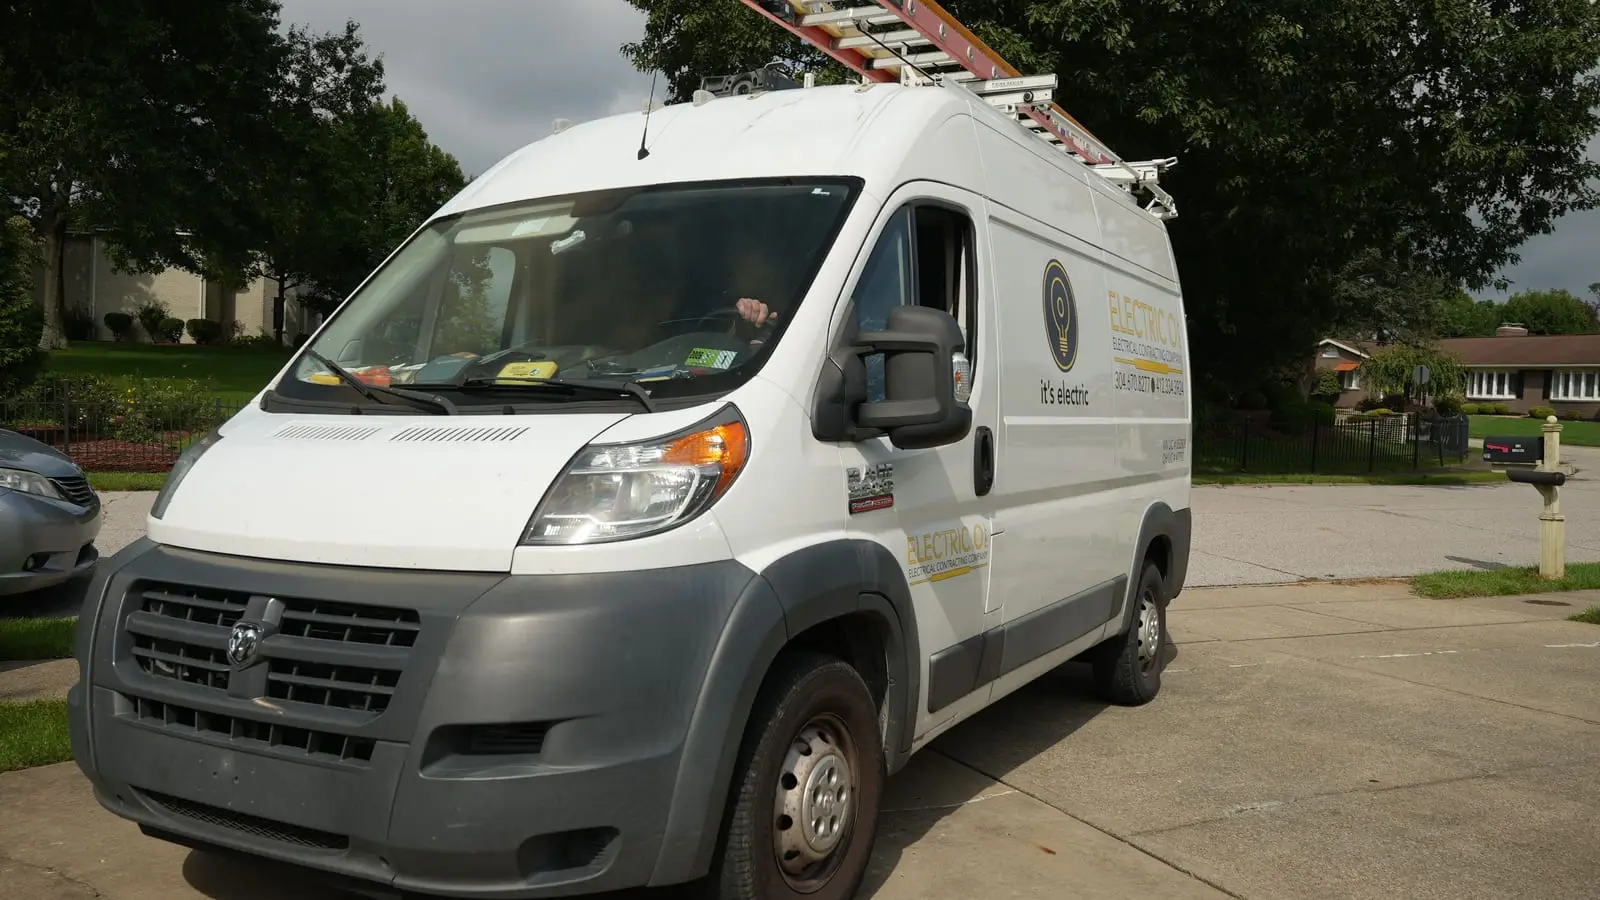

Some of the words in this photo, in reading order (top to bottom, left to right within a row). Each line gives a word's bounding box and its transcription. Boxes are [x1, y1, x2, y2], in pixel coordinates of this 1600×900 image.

[1108, 290, 1167, 345] ELECTRIC
[1112, 336, 1138, 355] ELECTRICAL
[1138, 343, 1166, 362] CONTRACTING
[1040, 379, 1054, 404] it's
[1057, 379, 1089, 406] electric
[906, 526, 970, 565] ELECTRIC
[908, 563, 936, 579] ELECTRICAL
[936, 555, 968, 572] CONTRACTING
[968, 551, 988, 564] COMPANY
